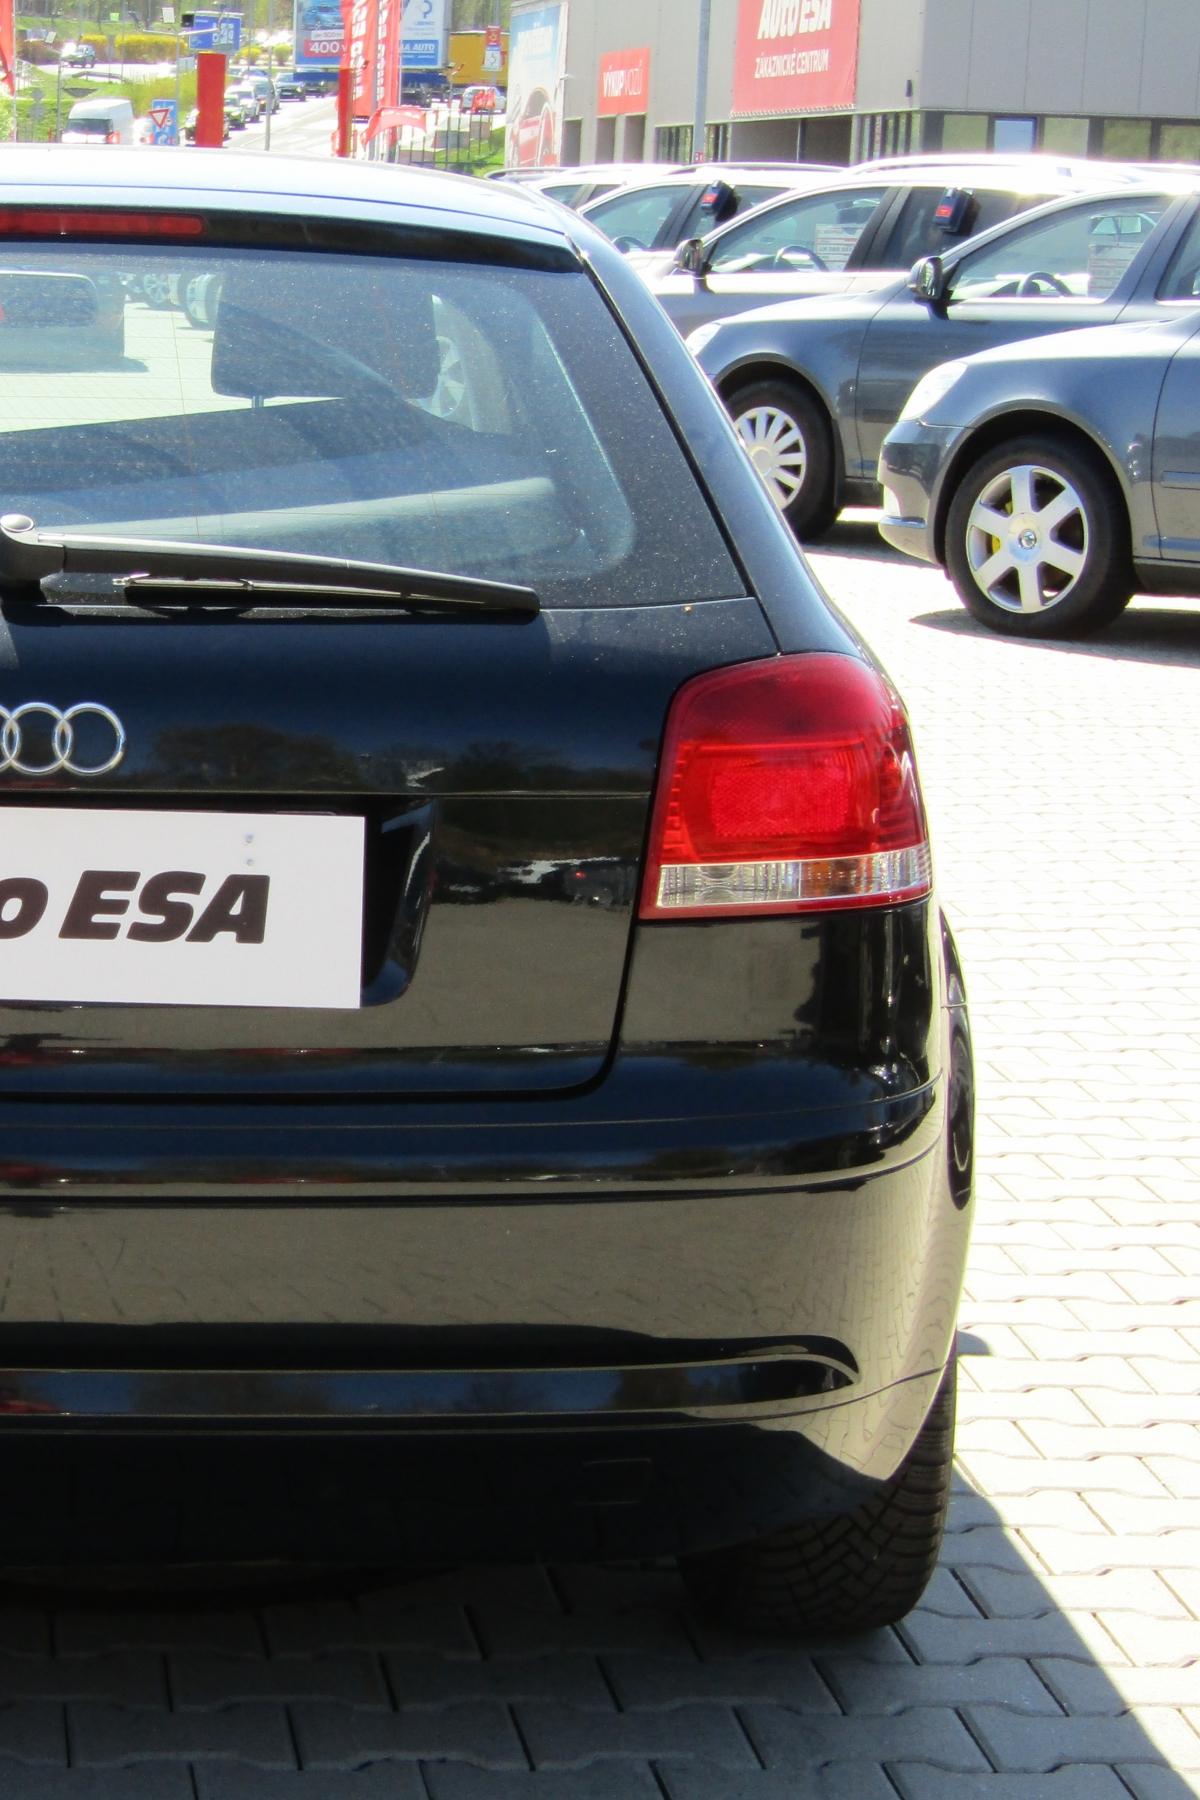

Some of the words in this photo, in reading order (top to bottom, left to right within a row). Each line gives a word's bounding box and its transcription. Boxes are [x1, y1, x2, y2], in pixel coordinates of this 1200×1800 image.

[309, 41, 340, 54] 400
[413, 43, 435, 51] AUTO
[796, 48, 830, 75] CENTRUM
[58, 869, 271, 943] ESA
